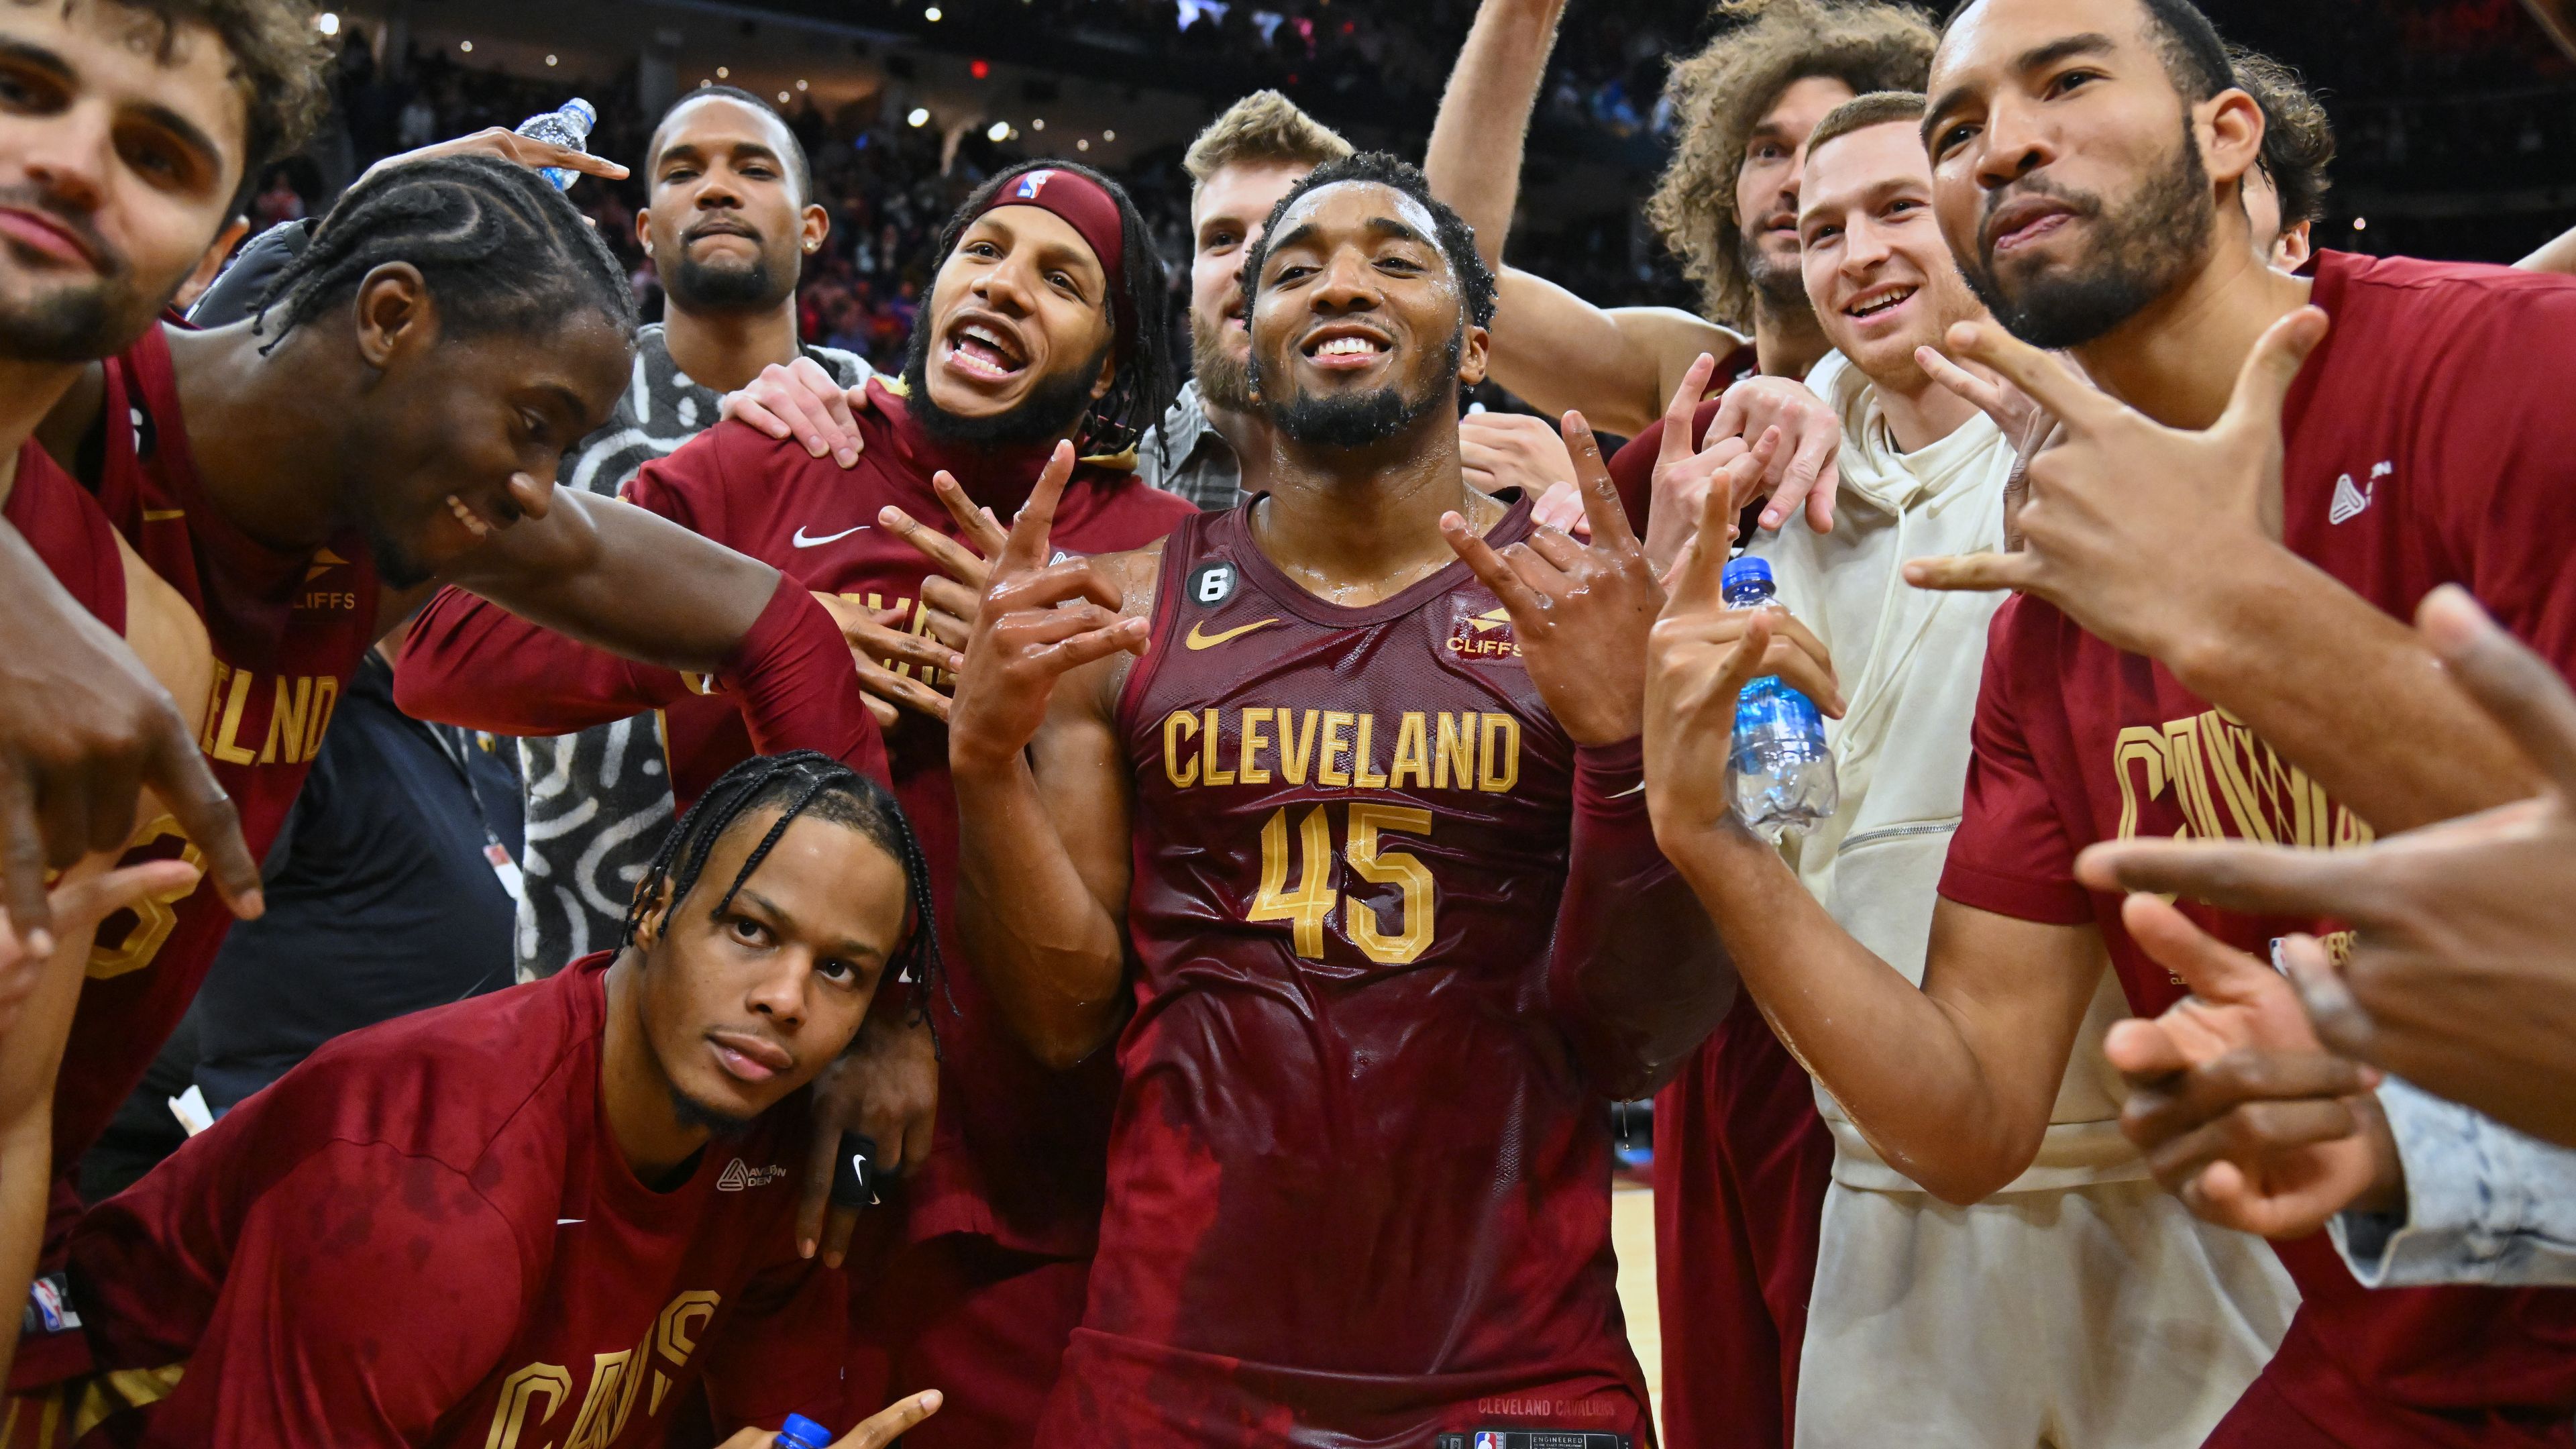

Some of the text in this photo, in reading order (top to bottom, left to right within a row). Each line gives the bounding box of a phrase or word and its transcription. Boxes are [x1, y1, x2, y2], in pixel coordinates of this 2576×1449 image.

[1199, 568, 1228, 602] 6
[1164, 707, 1521, 794] CLEVELAND
[1245, 802, 1435, 965] 45
[1478, 1397, 1551, 1417] CLEVELAND
